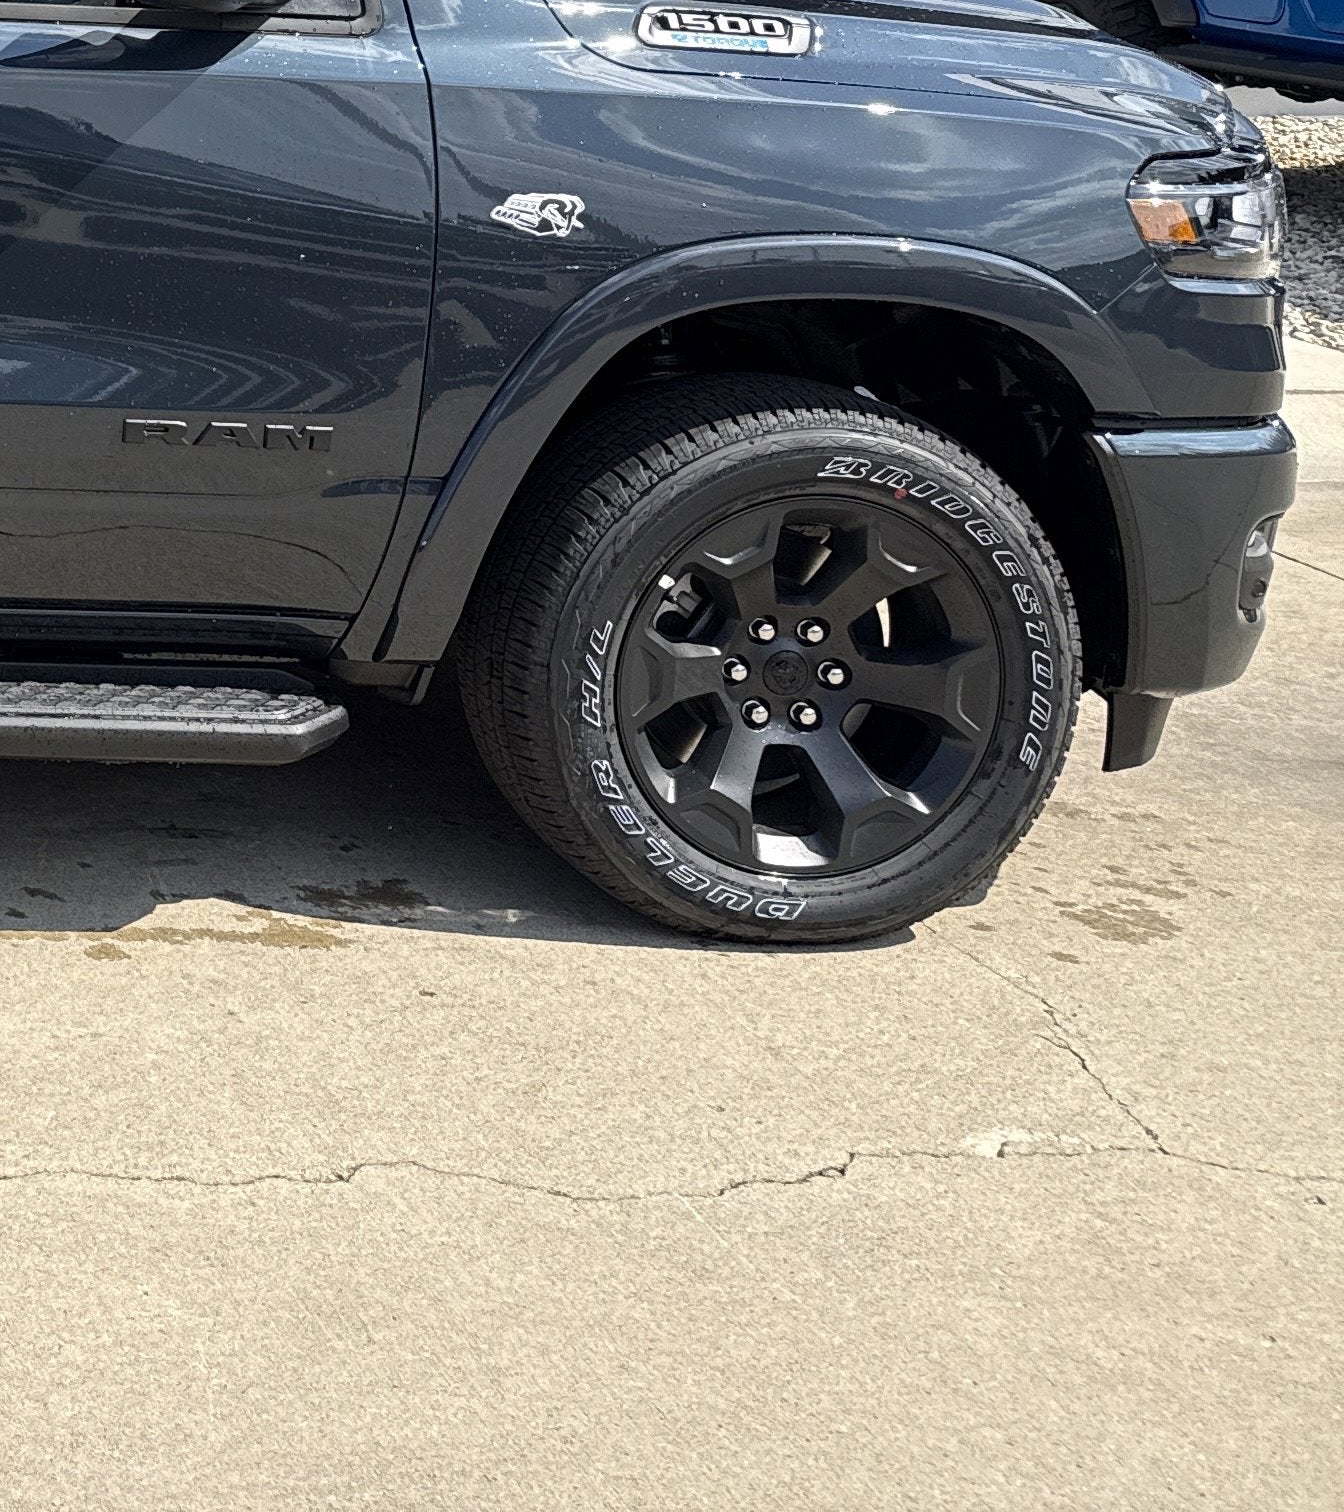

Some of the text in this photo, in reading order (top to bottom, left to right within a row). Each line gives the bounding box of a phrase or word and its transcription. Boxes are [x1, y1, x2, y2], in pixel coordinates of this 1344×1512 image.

[660, 11, 788, 37] 1500
[122, 418, 334, 451] RAM
[816, 455, 1054, 772] BRIDGESTONE
[580, 619, 808, 921] DUELER H/L
